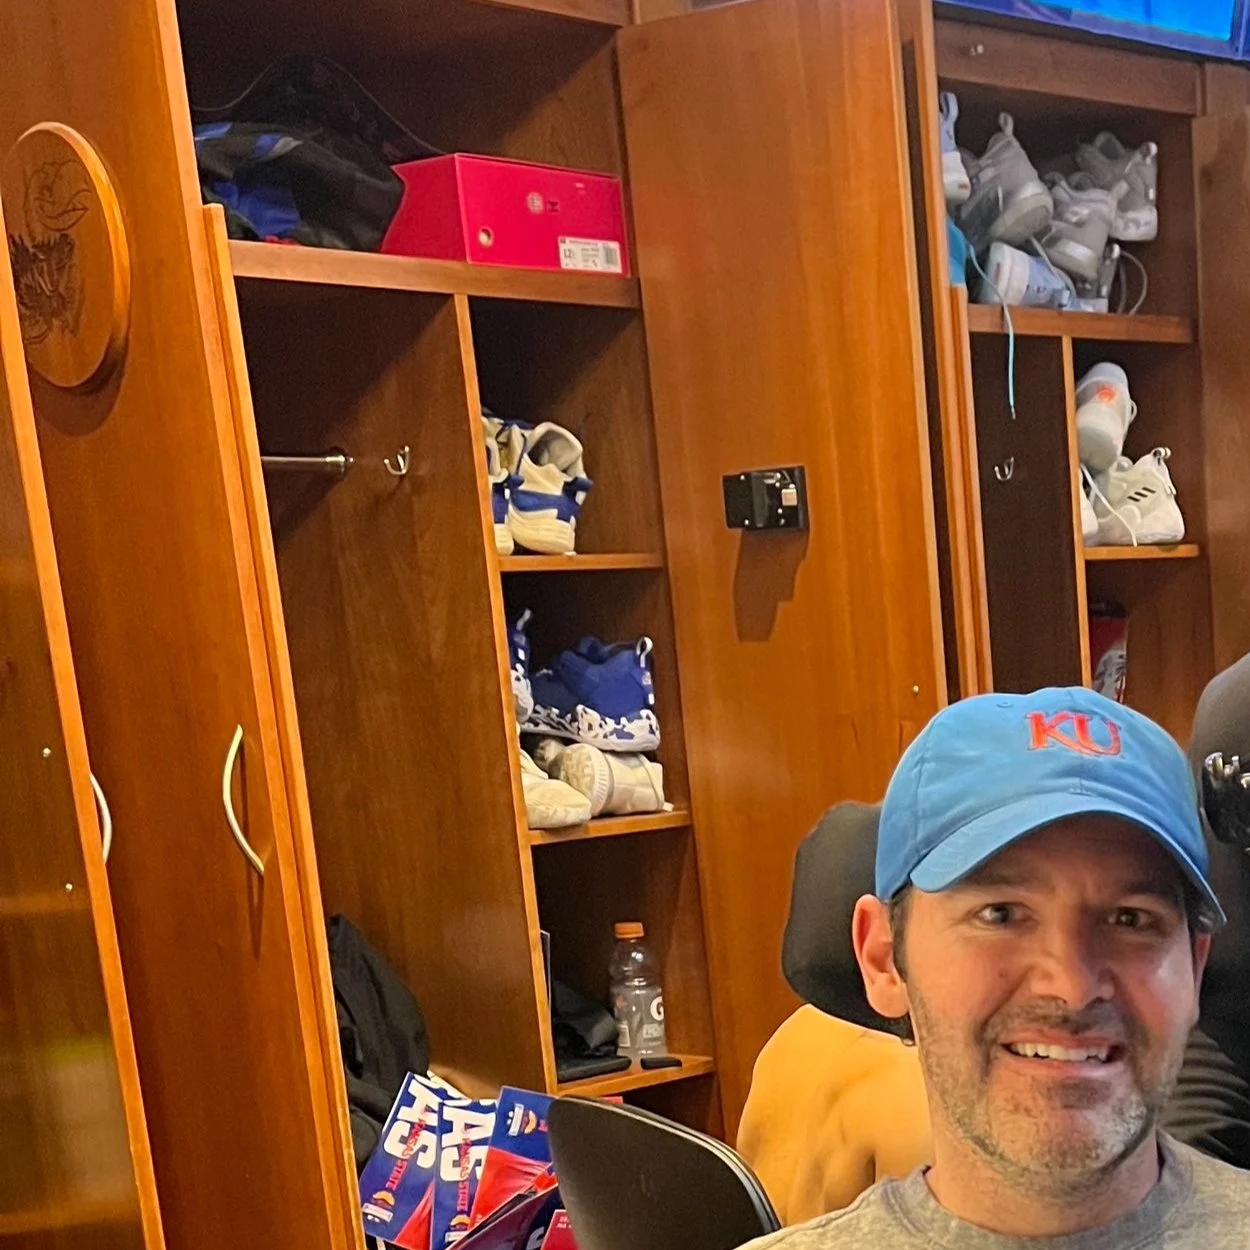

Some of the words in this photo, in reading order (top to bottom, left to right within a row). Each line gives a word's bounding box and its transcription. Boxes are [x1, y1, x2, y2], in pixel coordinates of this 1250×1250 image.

[1024, 710, 1122, 757] KU
[385, 1159, 408, 1191] STATE
[457, 1180, 470, 1212] STATE
